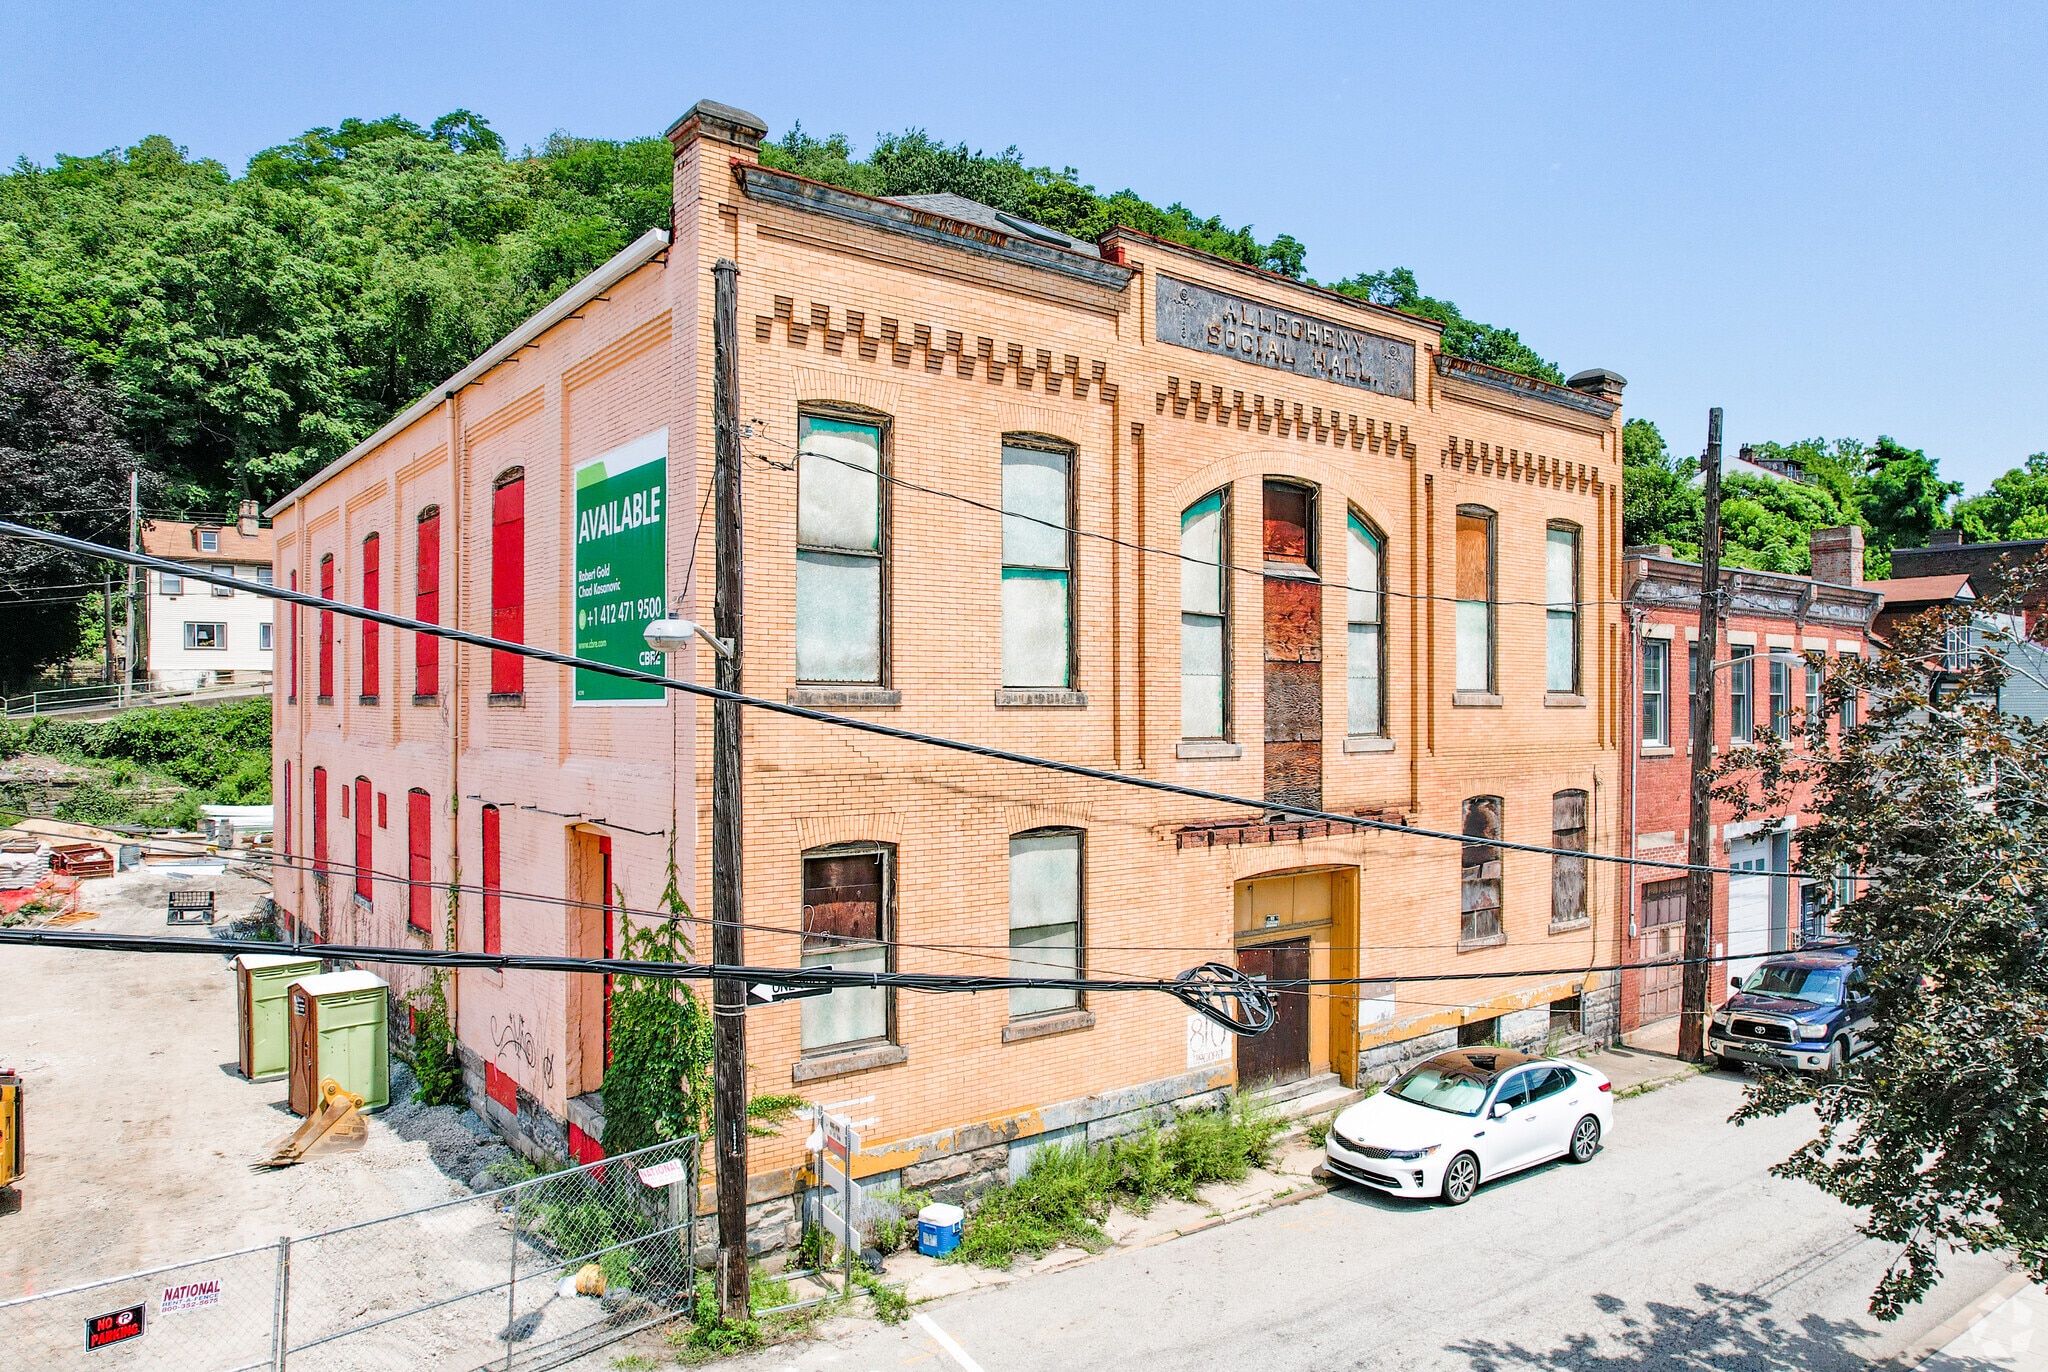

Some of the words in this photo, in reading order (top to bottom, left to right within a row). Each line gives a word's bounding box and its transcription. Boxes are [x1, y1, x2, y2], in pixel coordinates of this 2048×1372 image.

[1223, 303, 1364, 354] ALLEGHENY
[1208, 324, 1295, 364] SOCIAL
[578, 486, 660, 544] AVAILABLE
[578, 568, 595, 583] Robert
[596, 563, 610, 578] Gold
[578, 583, 593, 598] Chad
[587, 607, 598, 626] +1
[600, 604, 616, 624] 412
[618, 601, 634, 621] 471
[637, 596, 662, 619] 9500
[578, 639, 607, 649] www.cbre.com
[640, 1161, 681, 1178] NATIONAL
[162, 1293, 219, 1307] RENT-A-FENCE
[163, 1280, 221, 1301] NATIONAL
[97, 1316, 113, 1331] NO
[91, 1323, 139, 1347] PARKING
